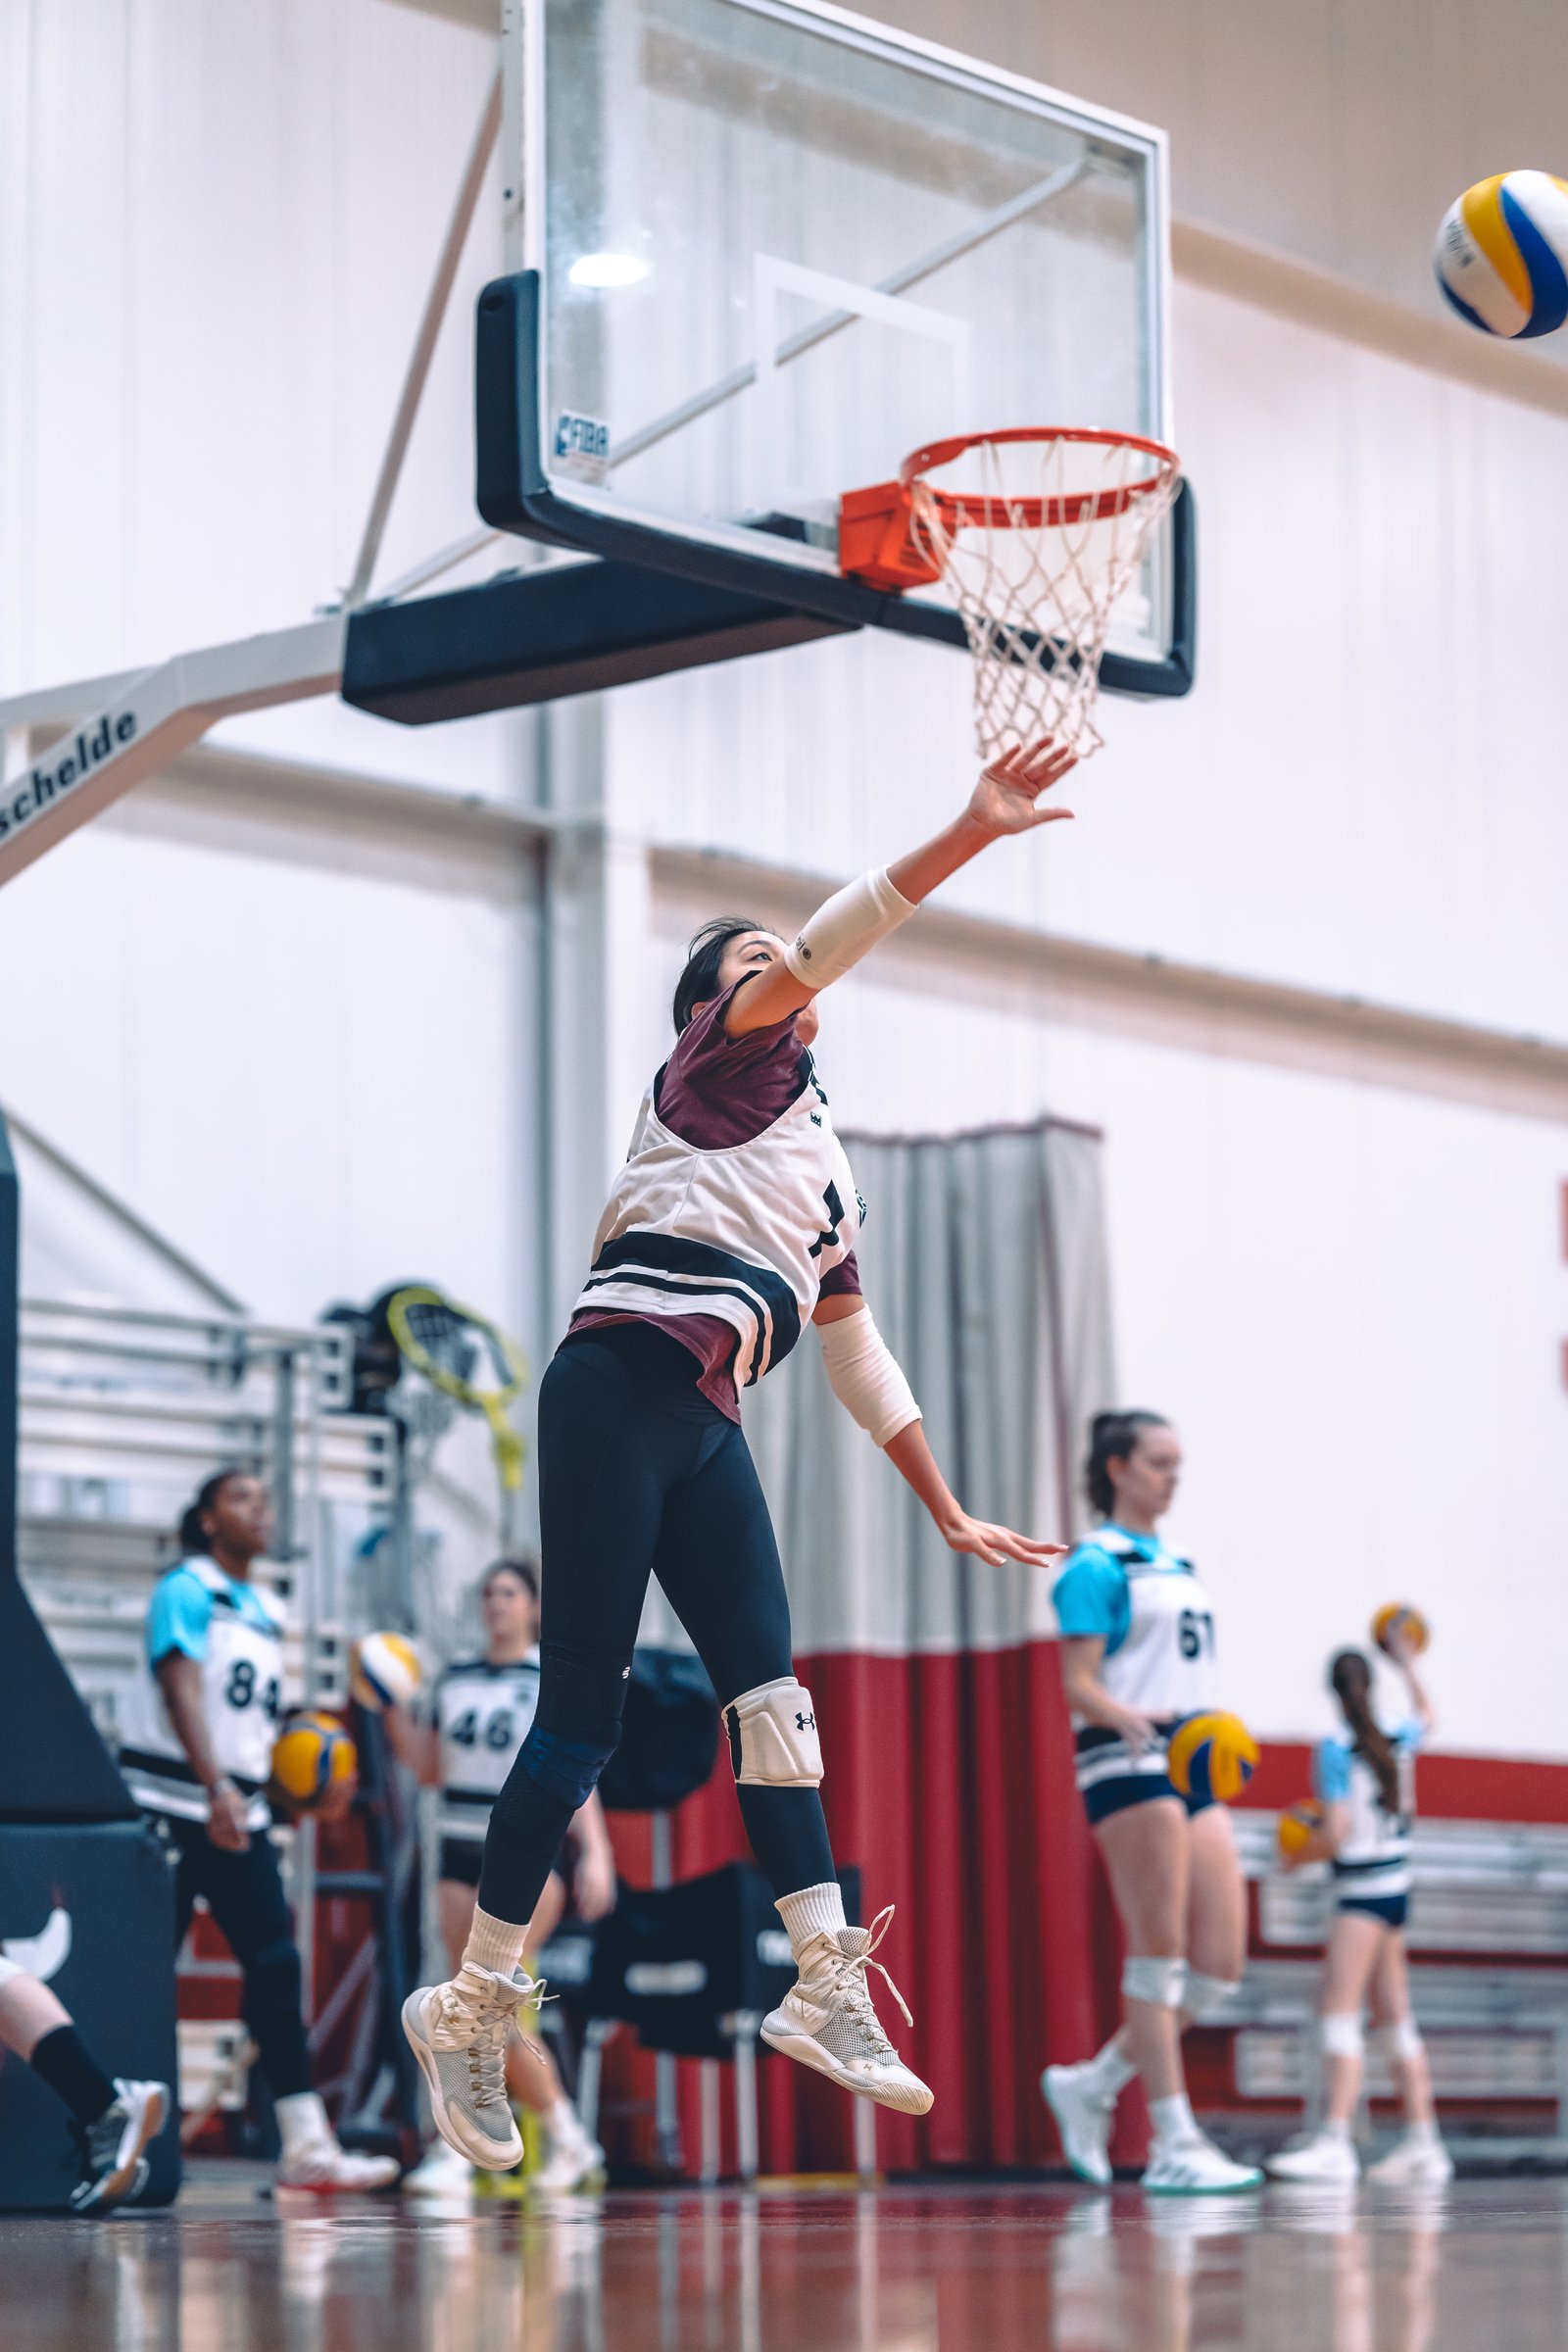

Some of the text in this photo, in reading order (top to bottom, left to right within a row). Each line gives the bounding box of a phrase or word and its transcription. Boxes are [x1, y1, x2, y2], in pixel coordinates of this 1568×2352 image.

[571, 417, 610, 457] FIBA
[226, 1658, 280, 1719] 84
[450, 1708, 515, 1752] 46
